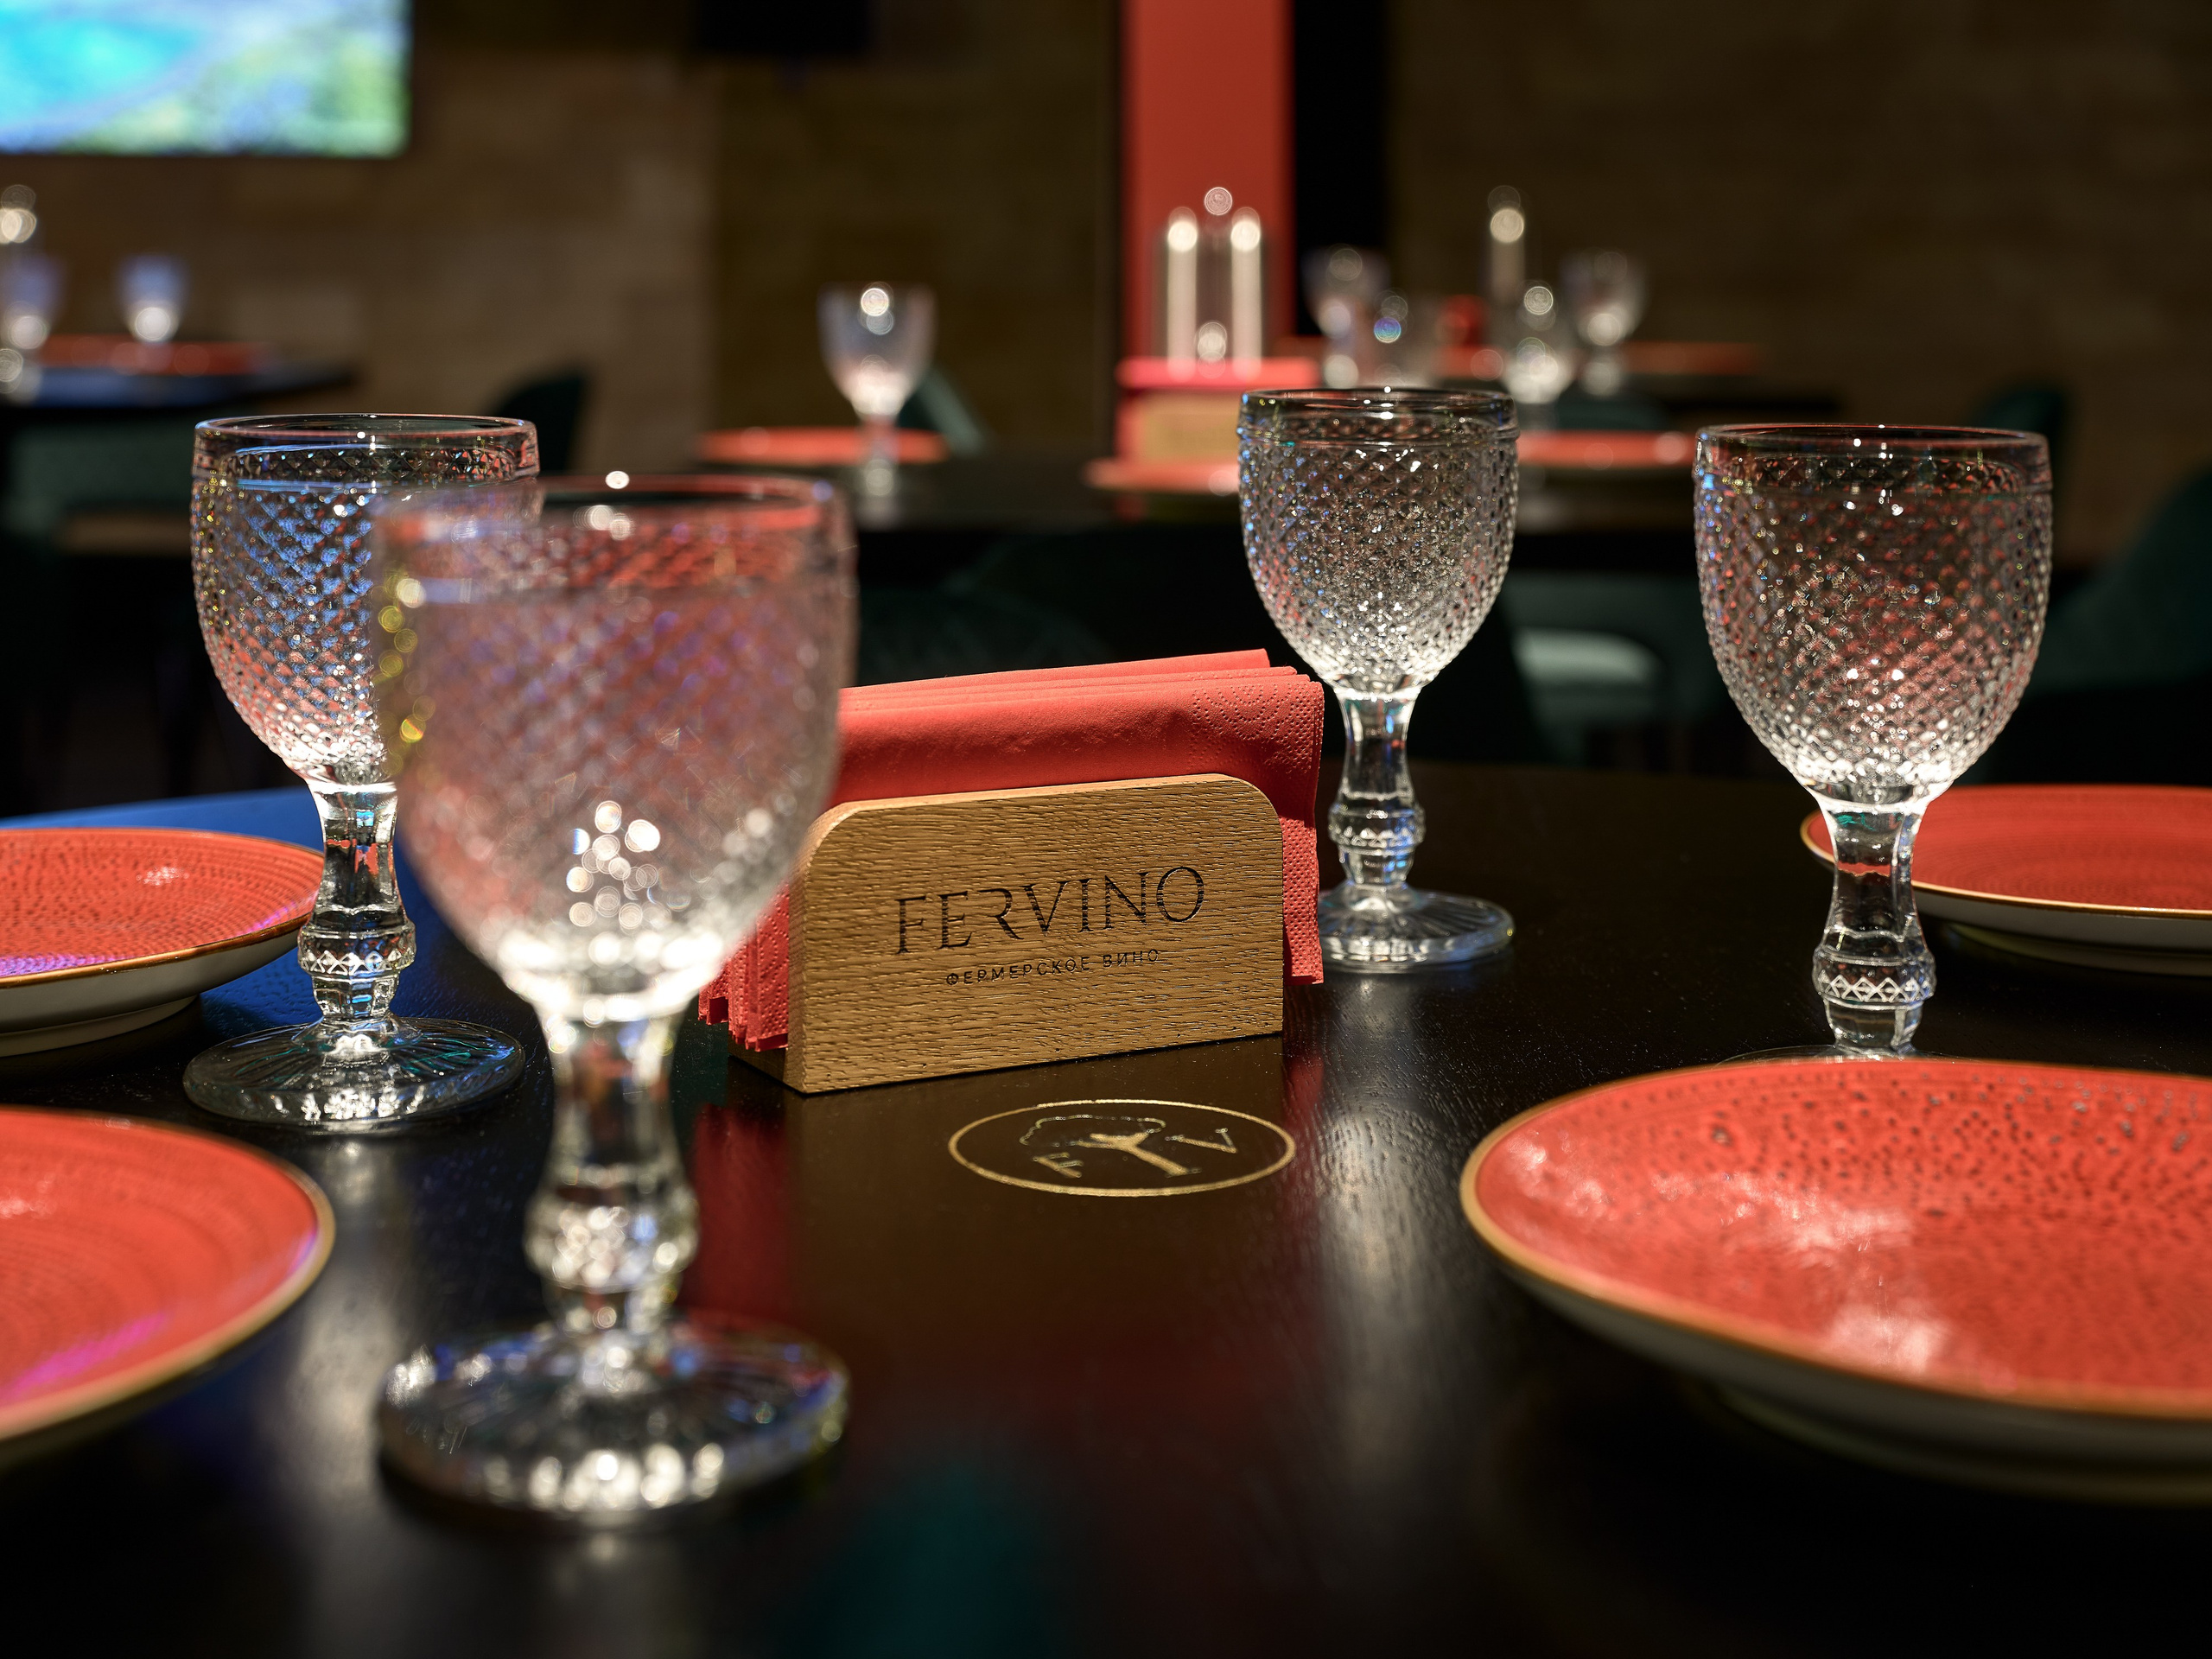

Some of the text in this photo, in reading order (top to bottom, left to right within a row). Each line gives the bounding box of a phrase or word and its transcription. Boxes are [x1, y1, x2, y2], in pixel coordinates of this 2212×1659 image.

[895, 866, 1205, 955] FERVINO
[945, 949, 1160, 986] ФЕРМЕРСКОЕ ВИНО
